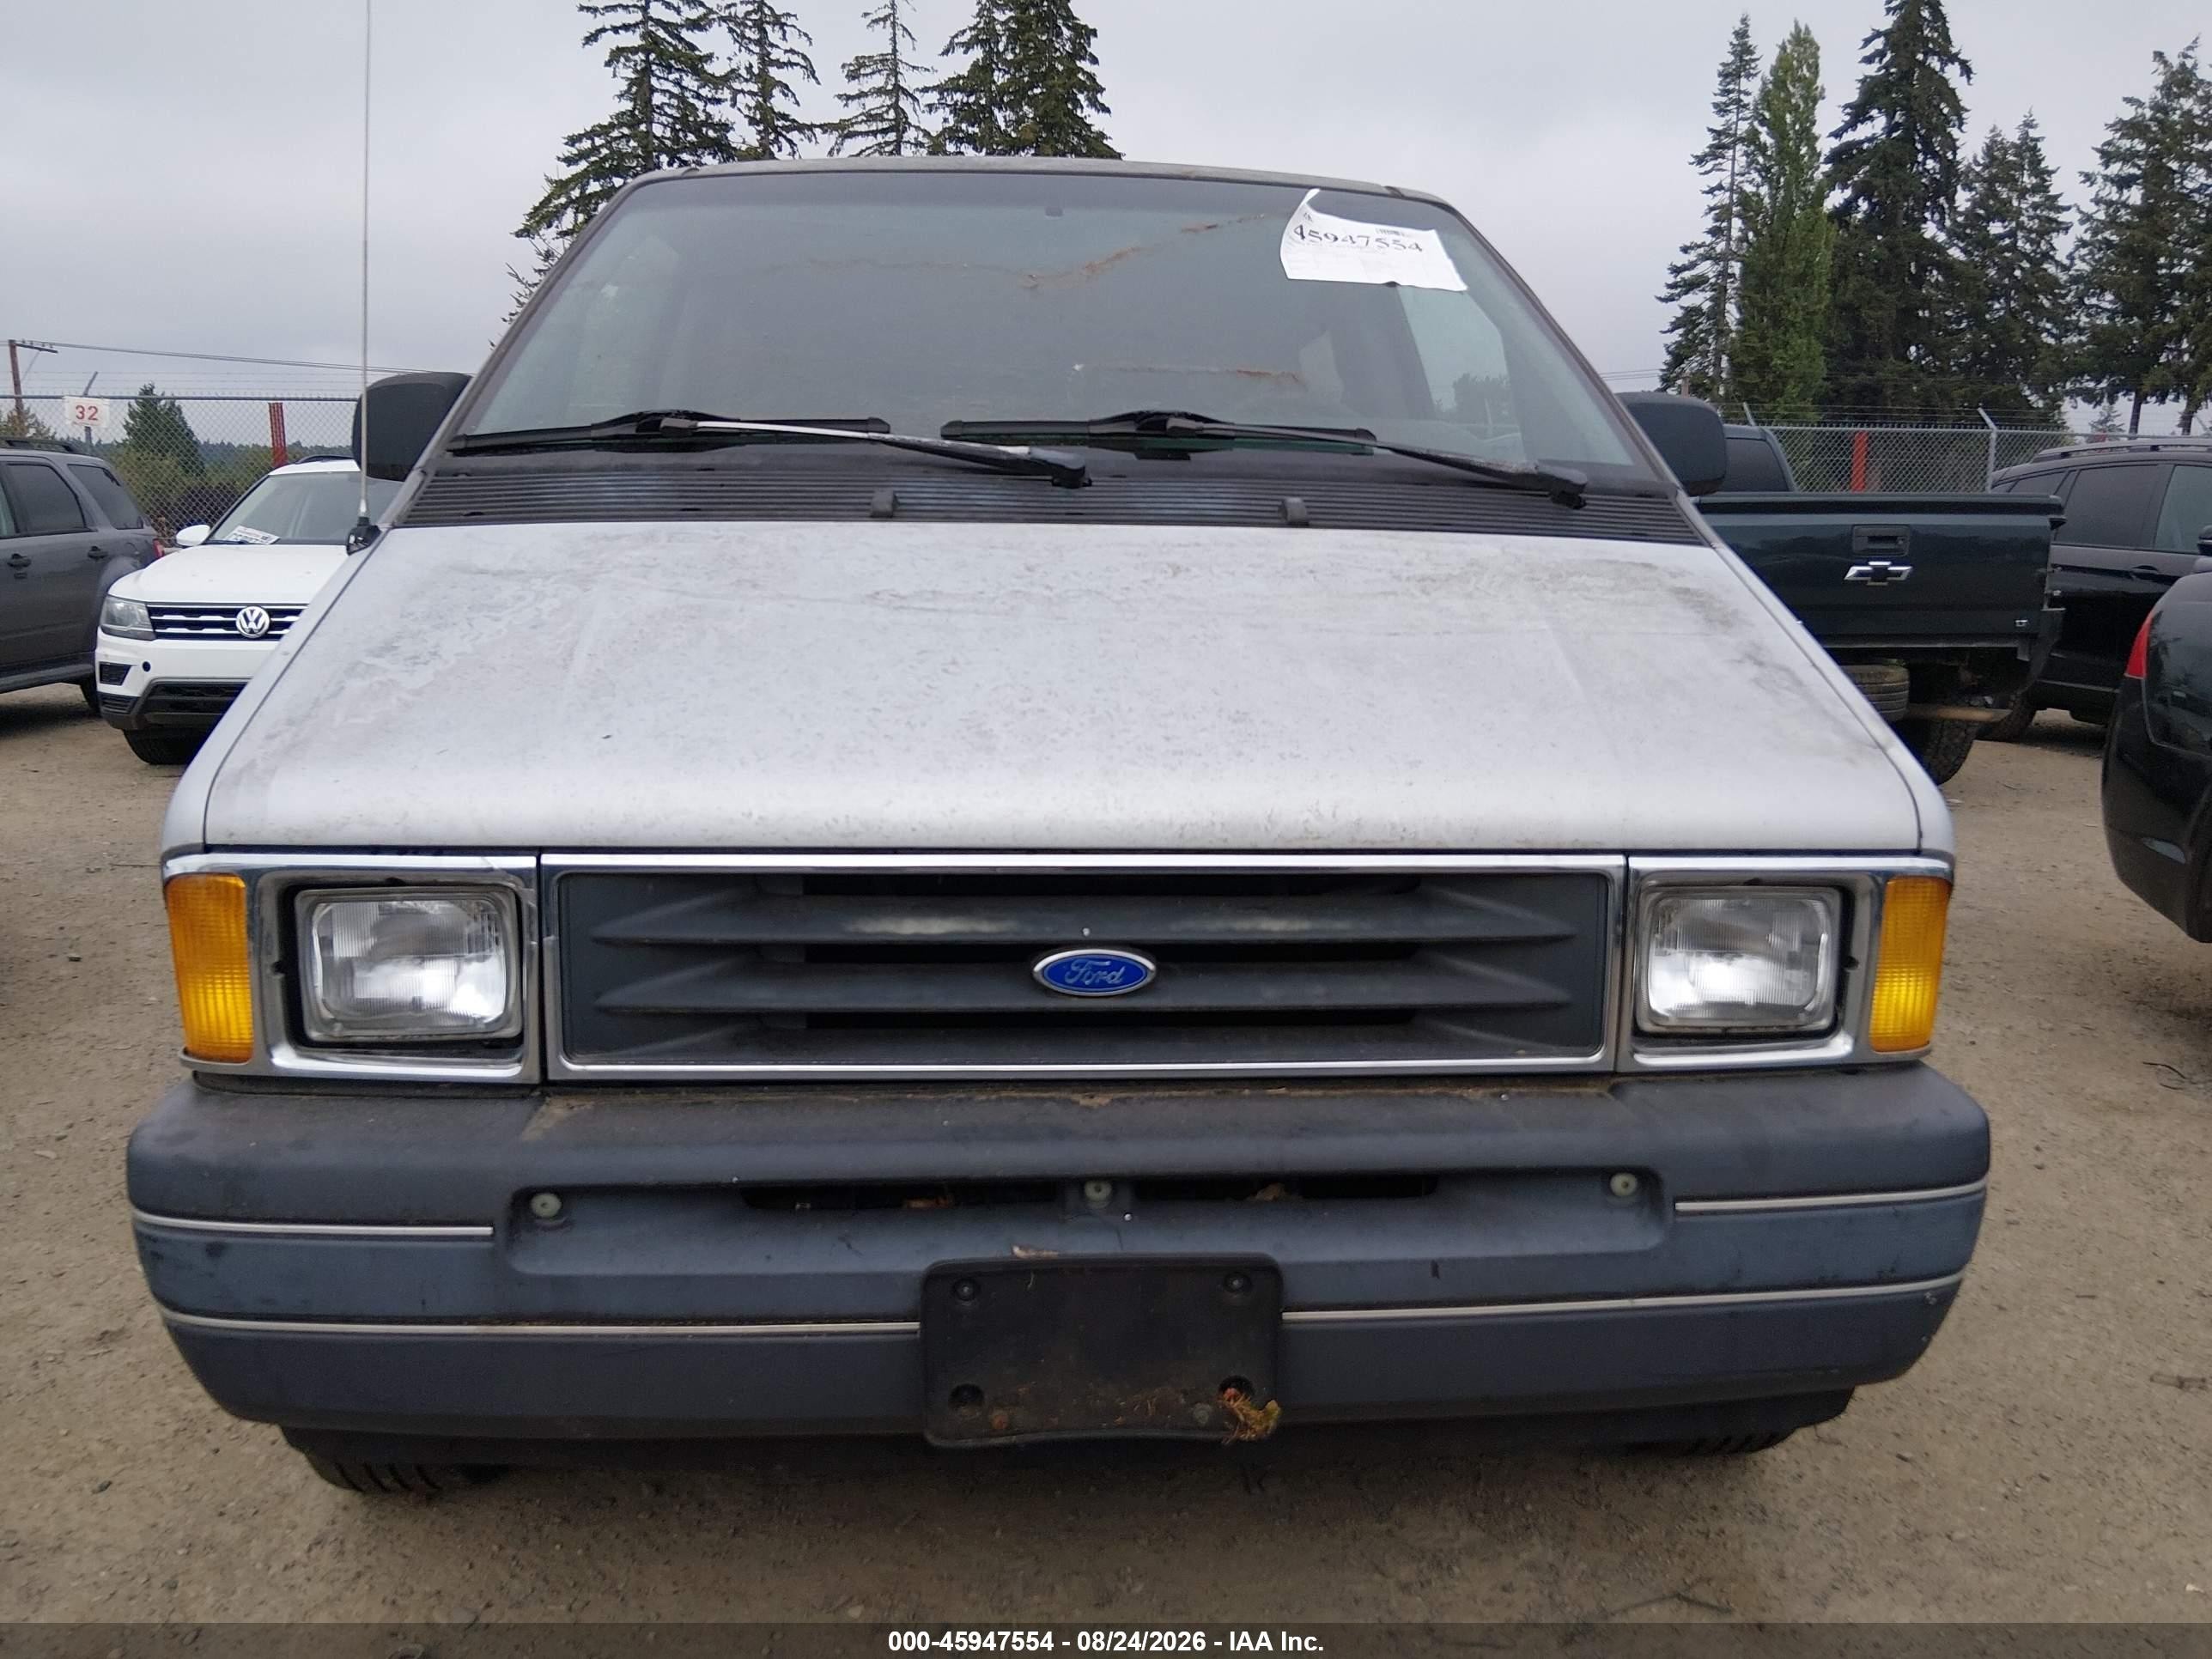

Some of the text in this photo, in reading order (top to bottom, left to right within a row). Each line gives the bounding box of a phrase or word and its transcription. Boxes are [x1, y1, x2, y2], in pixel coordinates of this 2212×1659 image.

[1294, 223, 1423, 252] 45947554
[76, 404, 99, 421] 32
[1064, 958, 1127, 986] Ford
